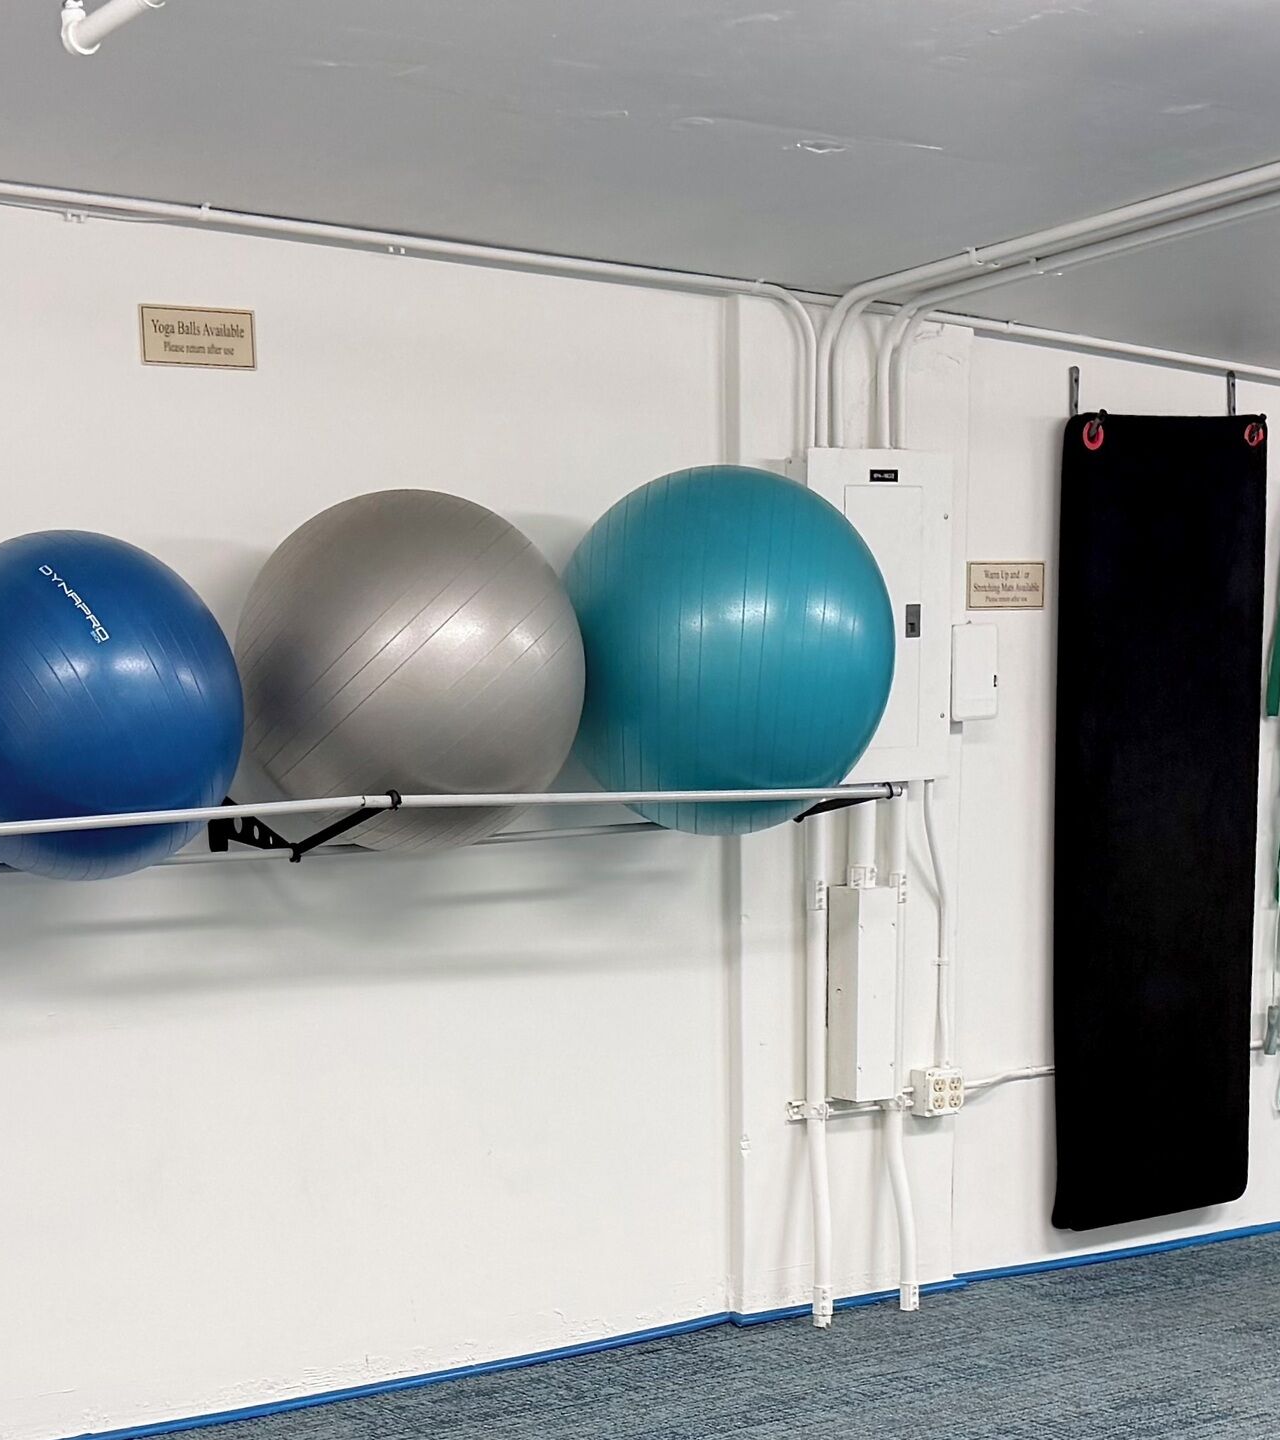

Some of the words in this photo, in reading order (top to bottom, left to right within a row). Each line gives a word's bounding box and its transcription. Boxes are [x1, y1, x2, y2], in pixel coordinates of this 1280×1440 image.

[151, 319, 175, 337] Yoga
[177, 320, 200, 336] Balls
[202, 323, 245, 339] Available
[163, 341, 185, 353] Please
[186, 343, 206, 354] return
[207, 343, 222, 355] after
[223, 347, 235, 356] use
[38, 564, 110, 641] DYNAPRO
